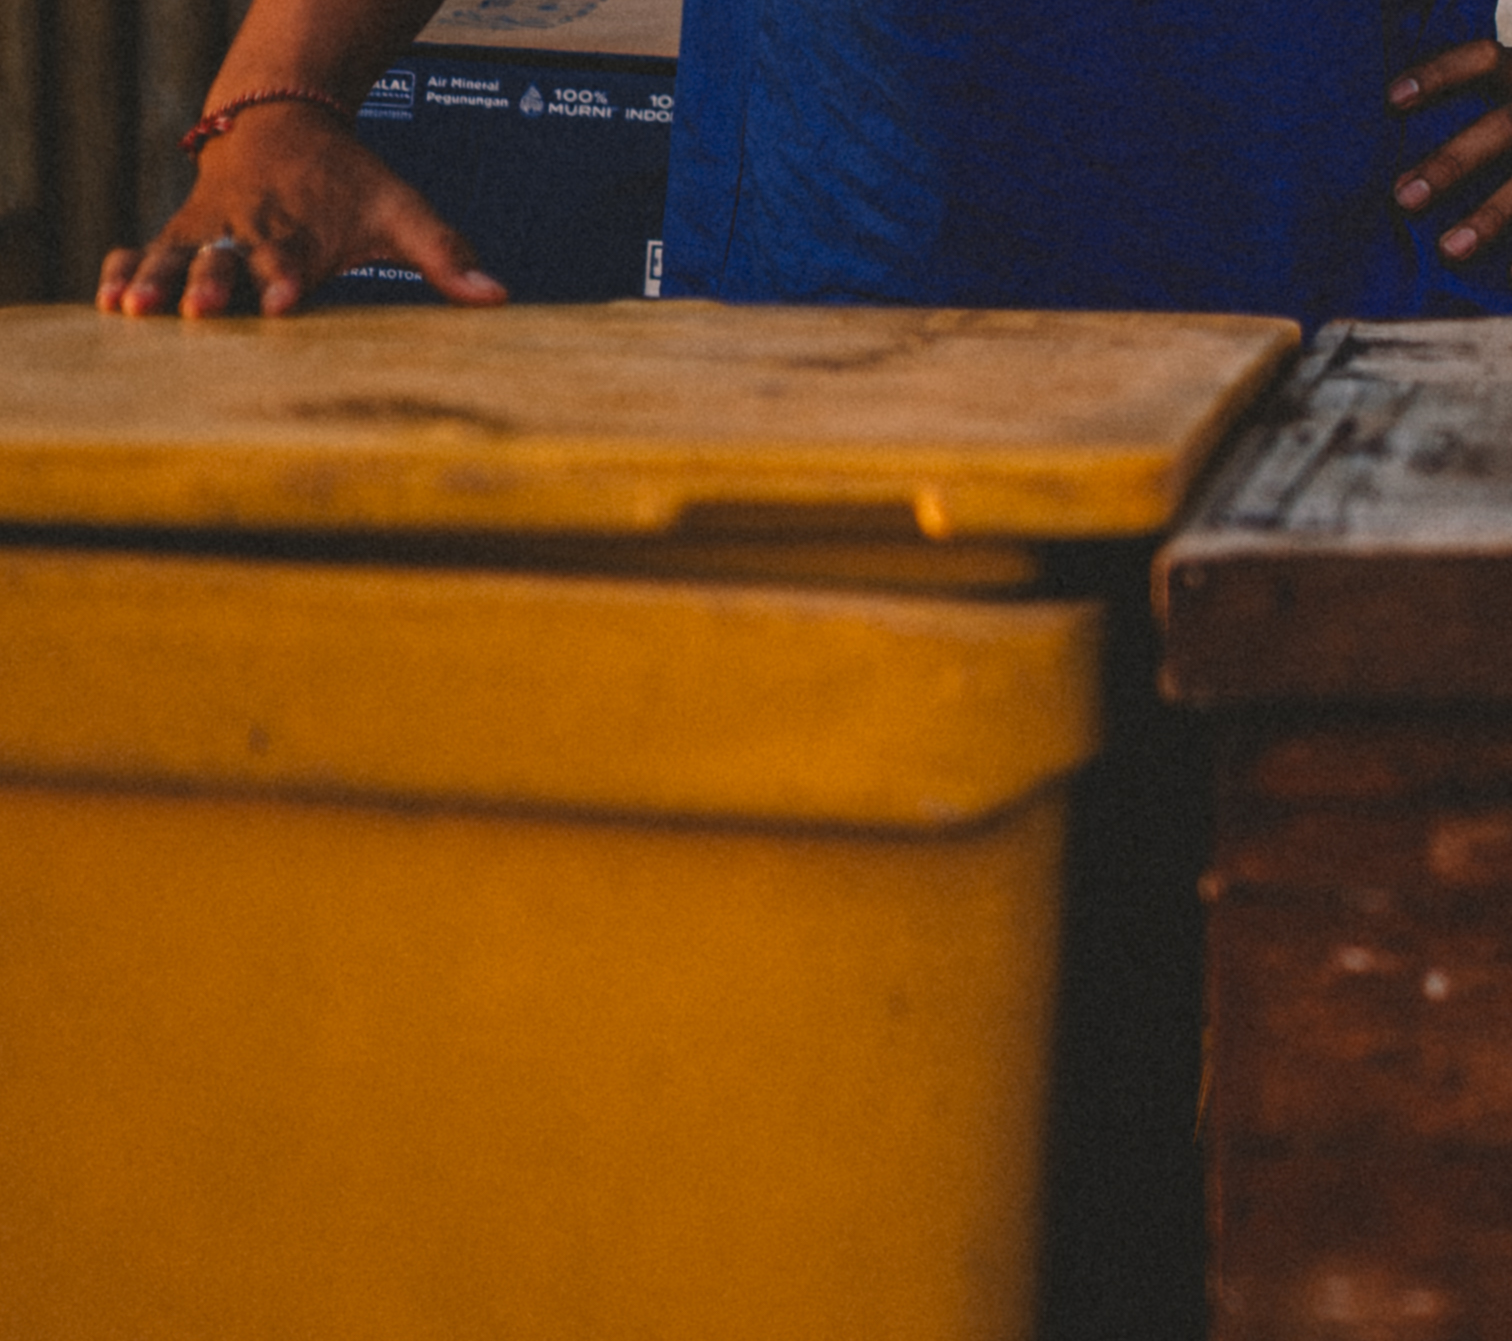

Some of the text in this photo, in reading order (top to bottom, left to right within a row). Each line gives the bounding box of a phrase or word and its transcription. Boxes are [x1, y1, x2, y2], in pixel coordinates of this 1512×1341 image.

[372, 78, 411, 92] ALAL
[427, 75, 500, 92] Air Mineral
[426, 91, 509, 109] Pegunungan
[554, 88, 608, 104] 100%
[650, 94, 675, 110] 10
[549, 102, 613, 118] MURNI
[625, 107, 675, 124] INDO
[342, 268, 374, 278] RAT
